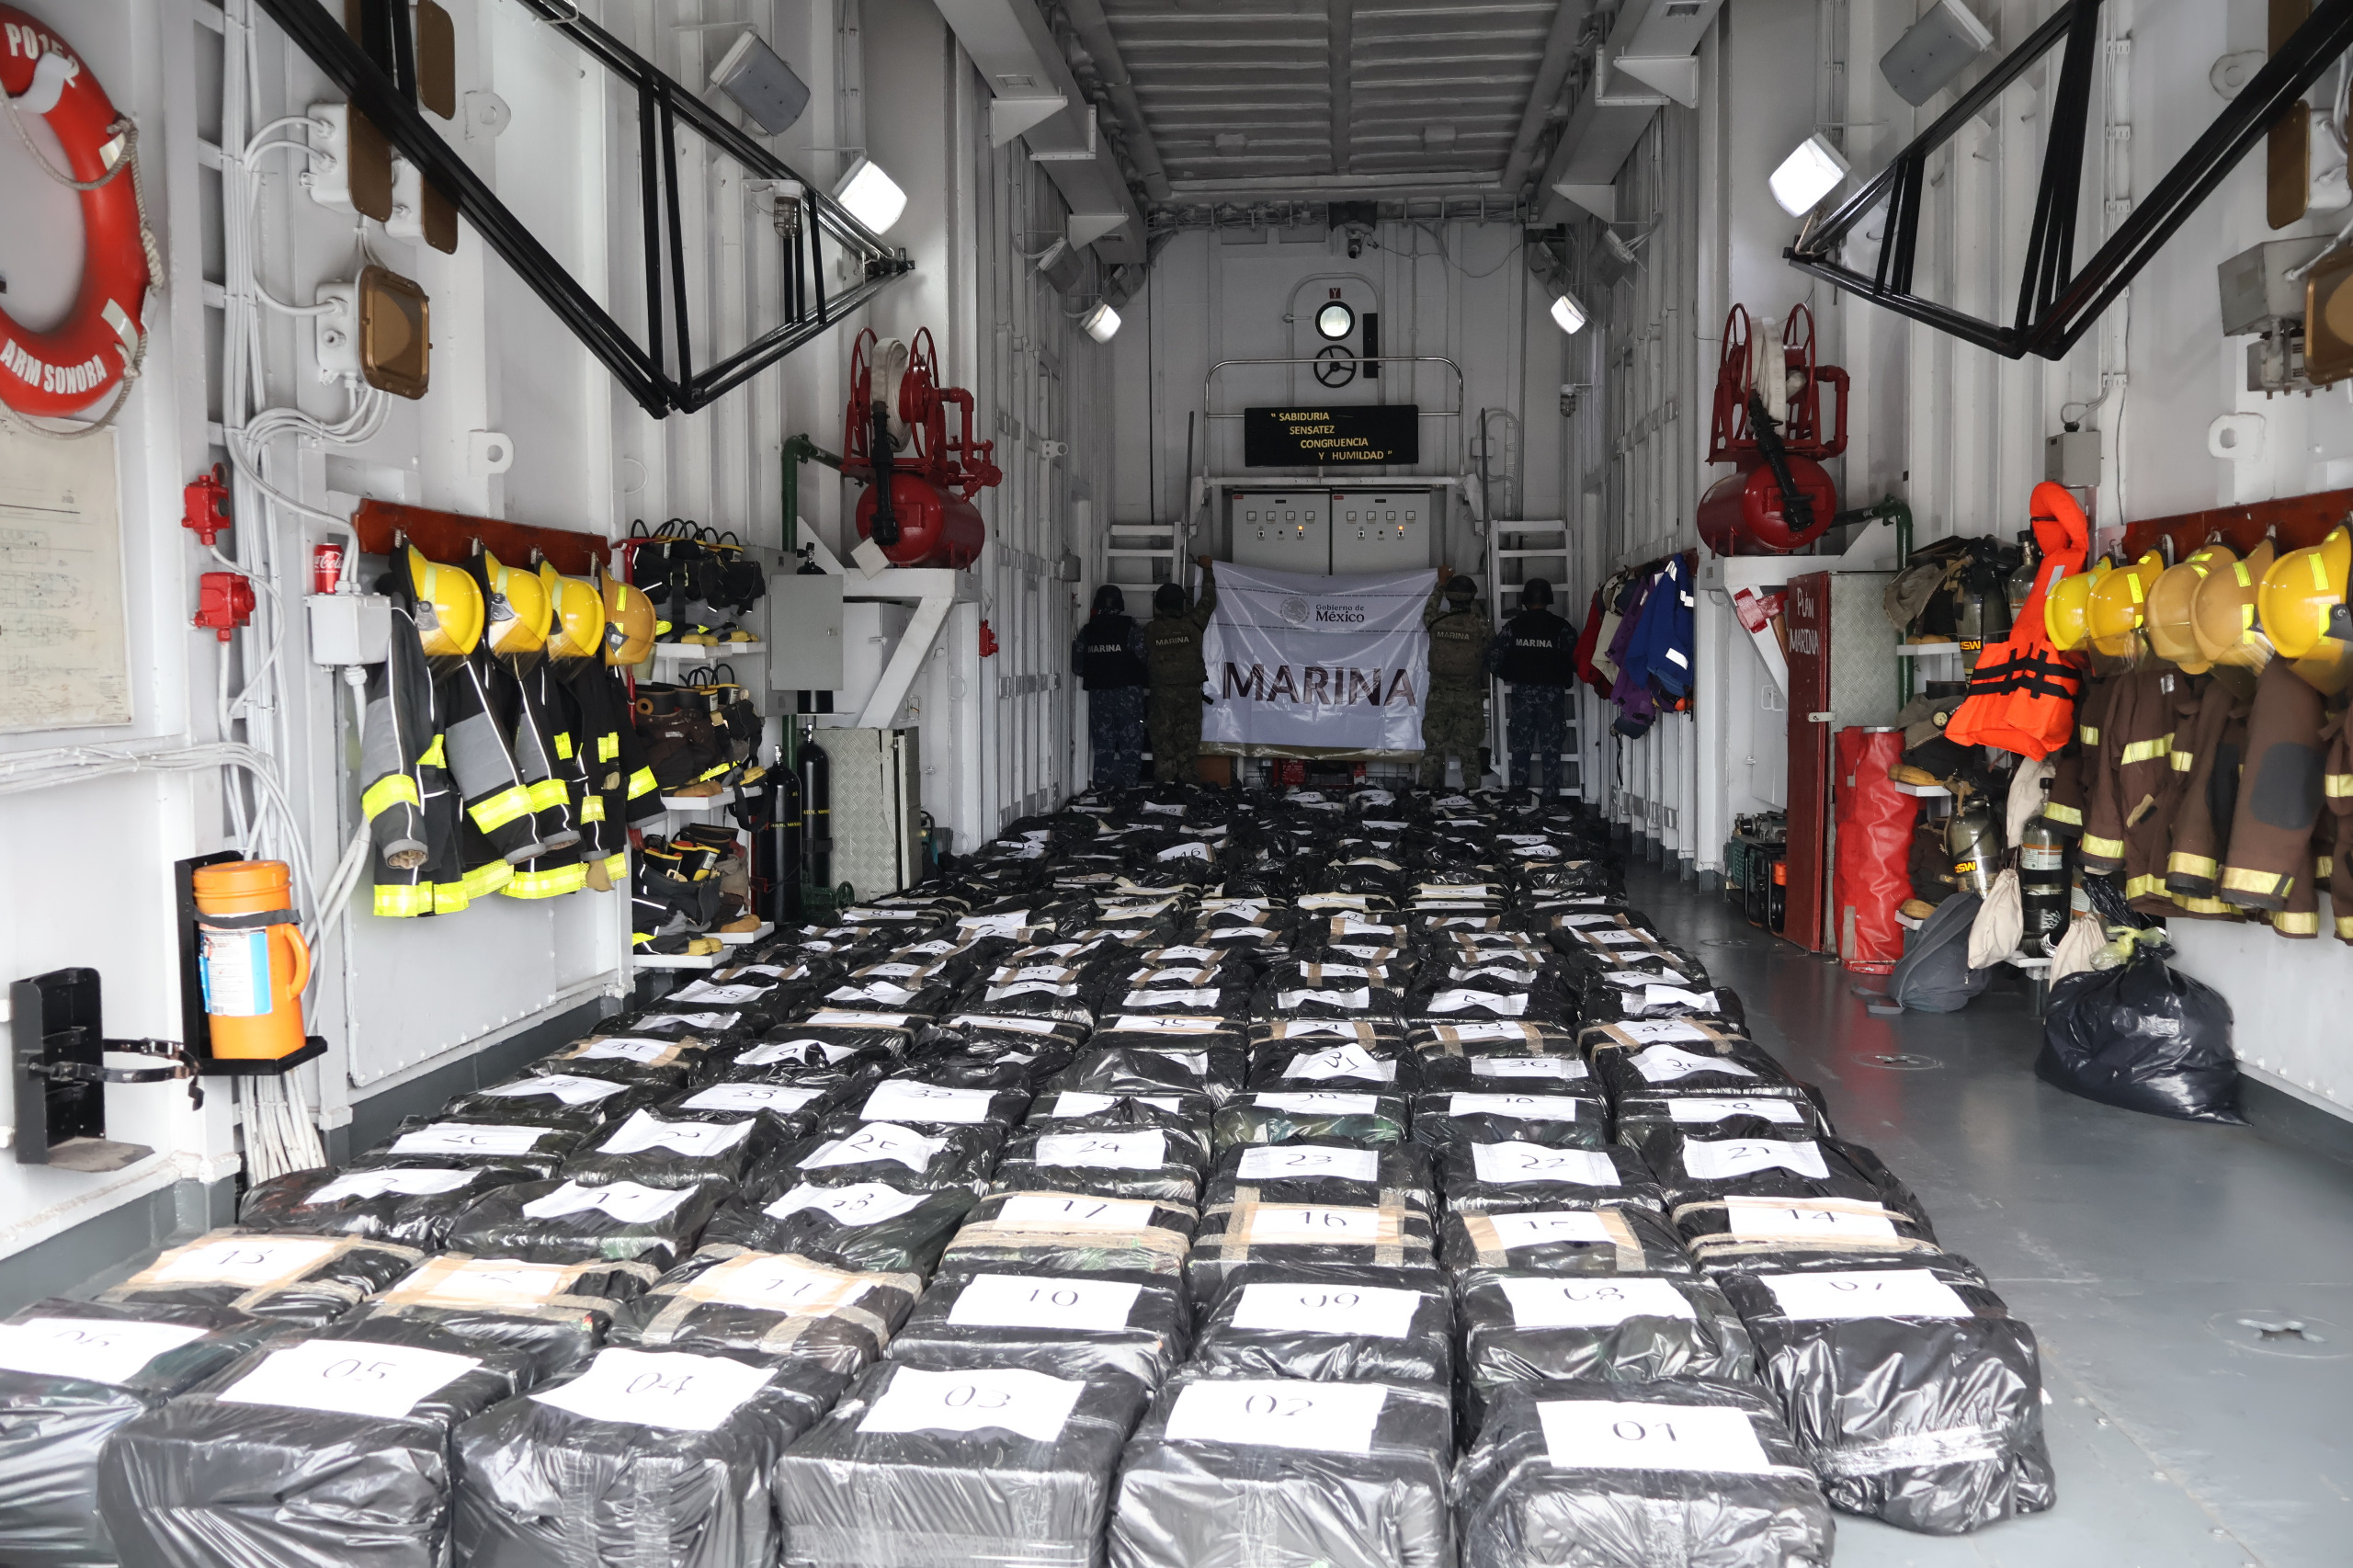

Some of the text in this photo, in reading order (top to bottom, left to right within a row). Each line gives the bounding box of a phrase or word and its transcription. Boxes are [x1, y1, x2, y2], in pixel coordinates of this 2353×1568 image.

[0, 339, 108, 394] ARM SONORA
[1279, 412, 1330, 422] SABIDURIA
[1289, 425, 1336, 436] SENSATEZ
[1300, 437, 1369, 449] CONGRUENCIA
[1318, 450, 1384, 460] Y HUMILDAD
[1315, 604, 1365, 612] Gobierno de
[1315, 611, 1365, 623] México
[1155, 636, 1190, 647] MARINA
[1437, 631, 1470, 641] MARINA
[1515, 638, 1552, 648] MARINA
[1789, 627, 1820, 655] MARINA
[1087, 643, 1122, 653] MARINA
[1222, 661, 1416, 707] MARINA
[907, 1089, 953, 1099] 32
[1075, 1140, 1123, 1154] 24
[1727, 1145, 1771, 1161] 21
[1284, 1153, 1333, 1168] 23
[1520, 1153, 1570, 1171] 22
[1297, 1210, 1348, 1228] 16
[1782, 1207, 1841, 1224] 14
[1026, 1288, 1079, 1307] 10
[322, 1358, 398, 1382] 05
[625, 1371, 695, 1396] 04
[943, 1384, 1017, 1410] 03
[1243, 1393, 1314, 1416] 02
[1610, 1419, 1678, 1443] 01
